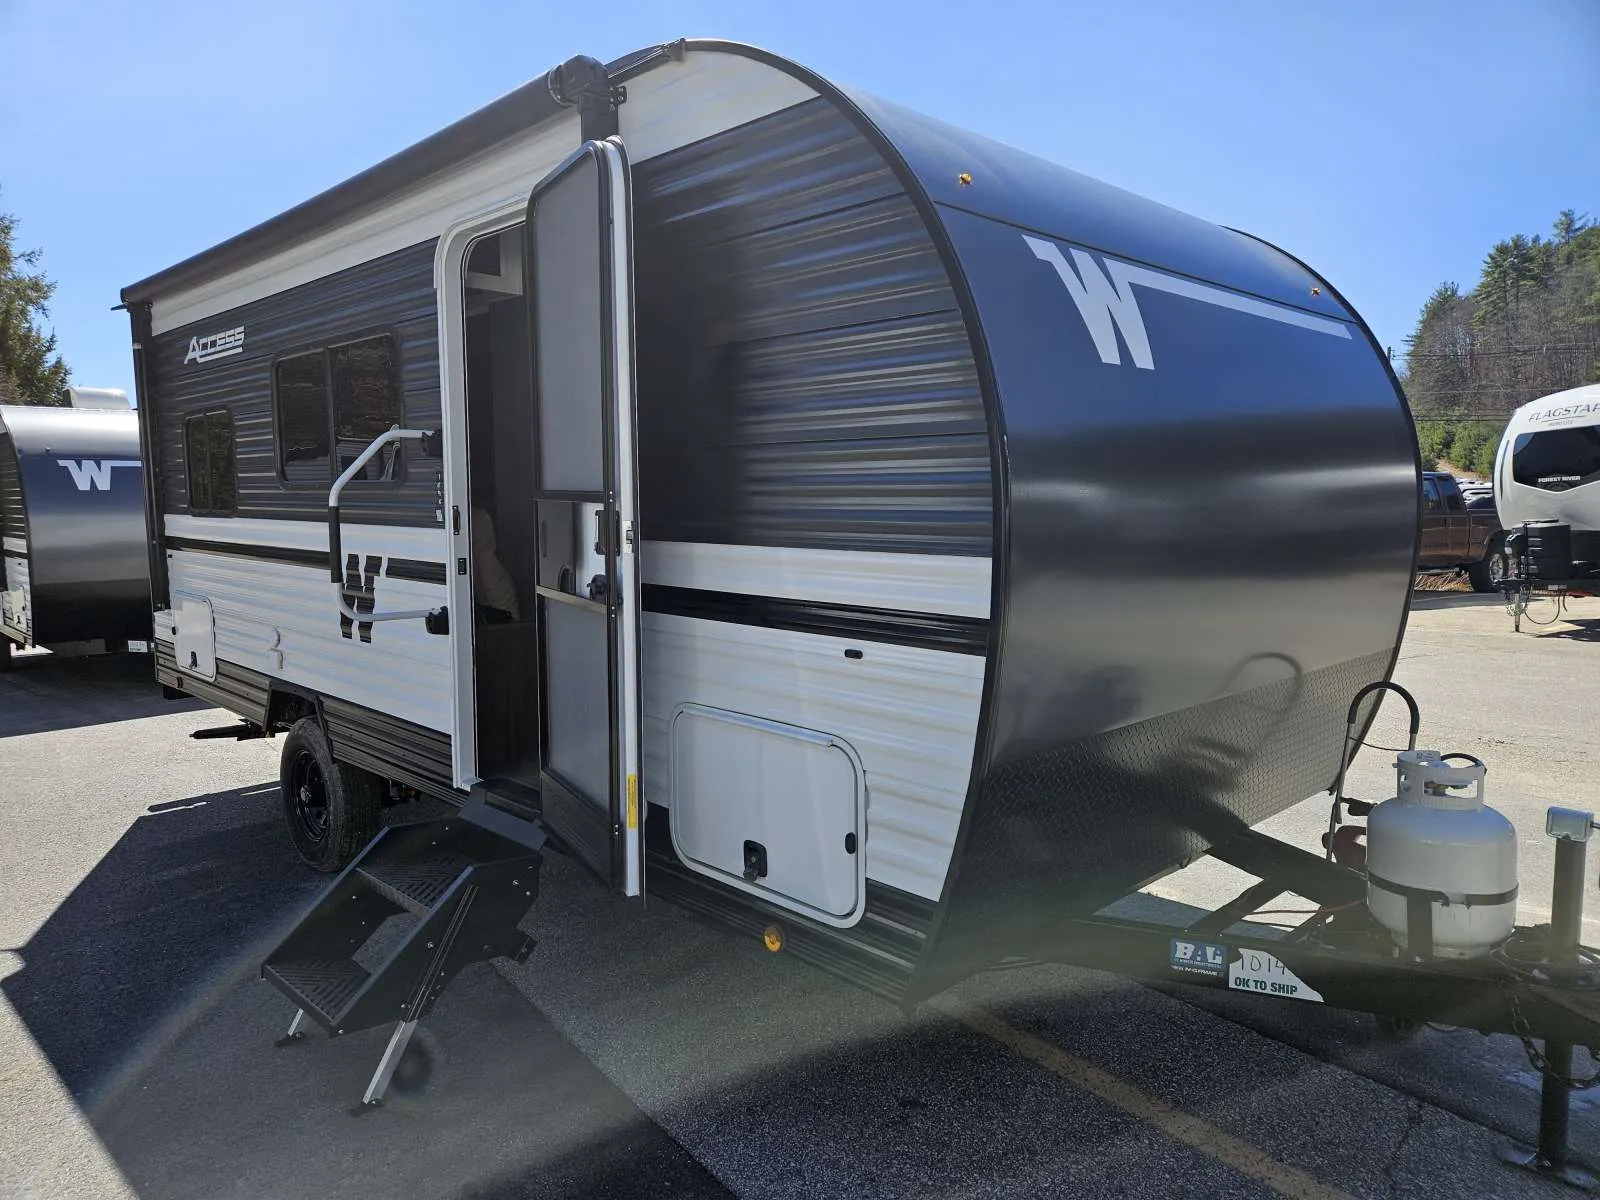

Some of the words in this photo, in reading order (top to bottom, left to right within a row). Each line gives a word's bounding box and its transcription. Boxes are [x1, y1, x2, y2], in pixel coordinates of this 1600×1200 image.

[184, 326, 245, 364] ACCESS
[1234, 976, 1250, 989] OK
[1253, 979, 1267, 991] TO
[1270, 982, 1298, 995] SHIP
